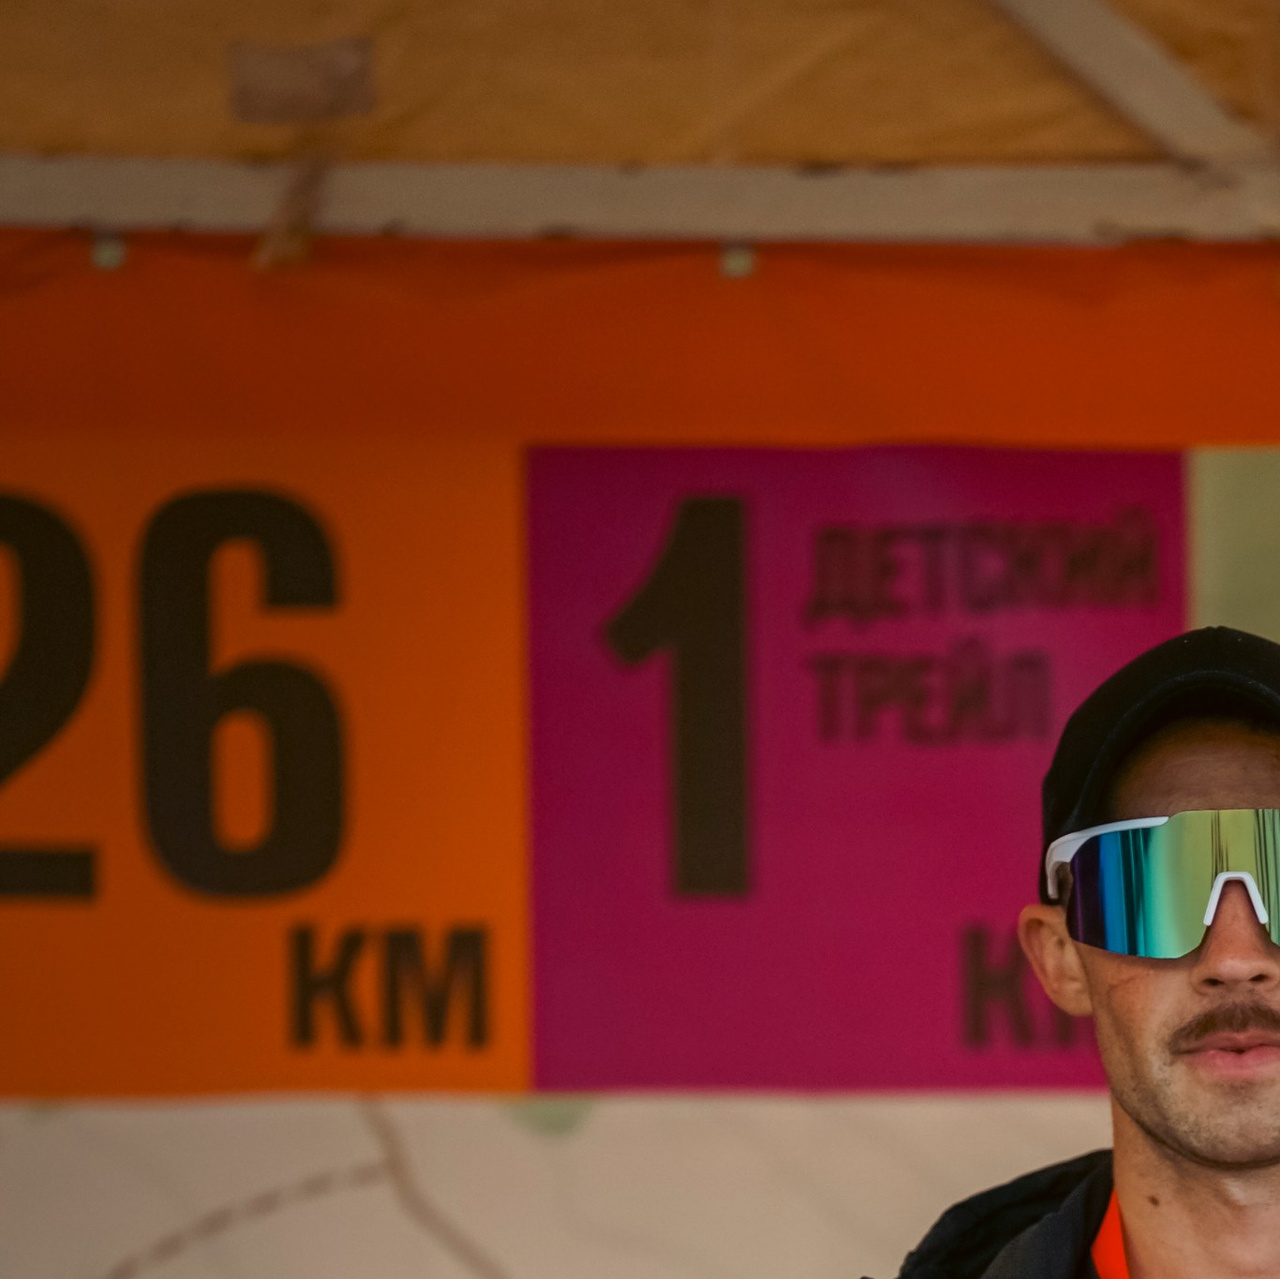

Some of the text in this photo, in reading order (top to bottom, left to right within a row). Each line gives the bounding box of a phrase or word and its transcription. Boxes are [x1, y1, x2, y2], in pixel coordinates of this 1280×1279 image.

[812, 505, 1160, 620] ДЕТСКИЙ
[605, 495, 752, 898] 1
[815, 645, 1050, 745] ТРЕЙЛ
[288, 925, 492, 1050] КМ
